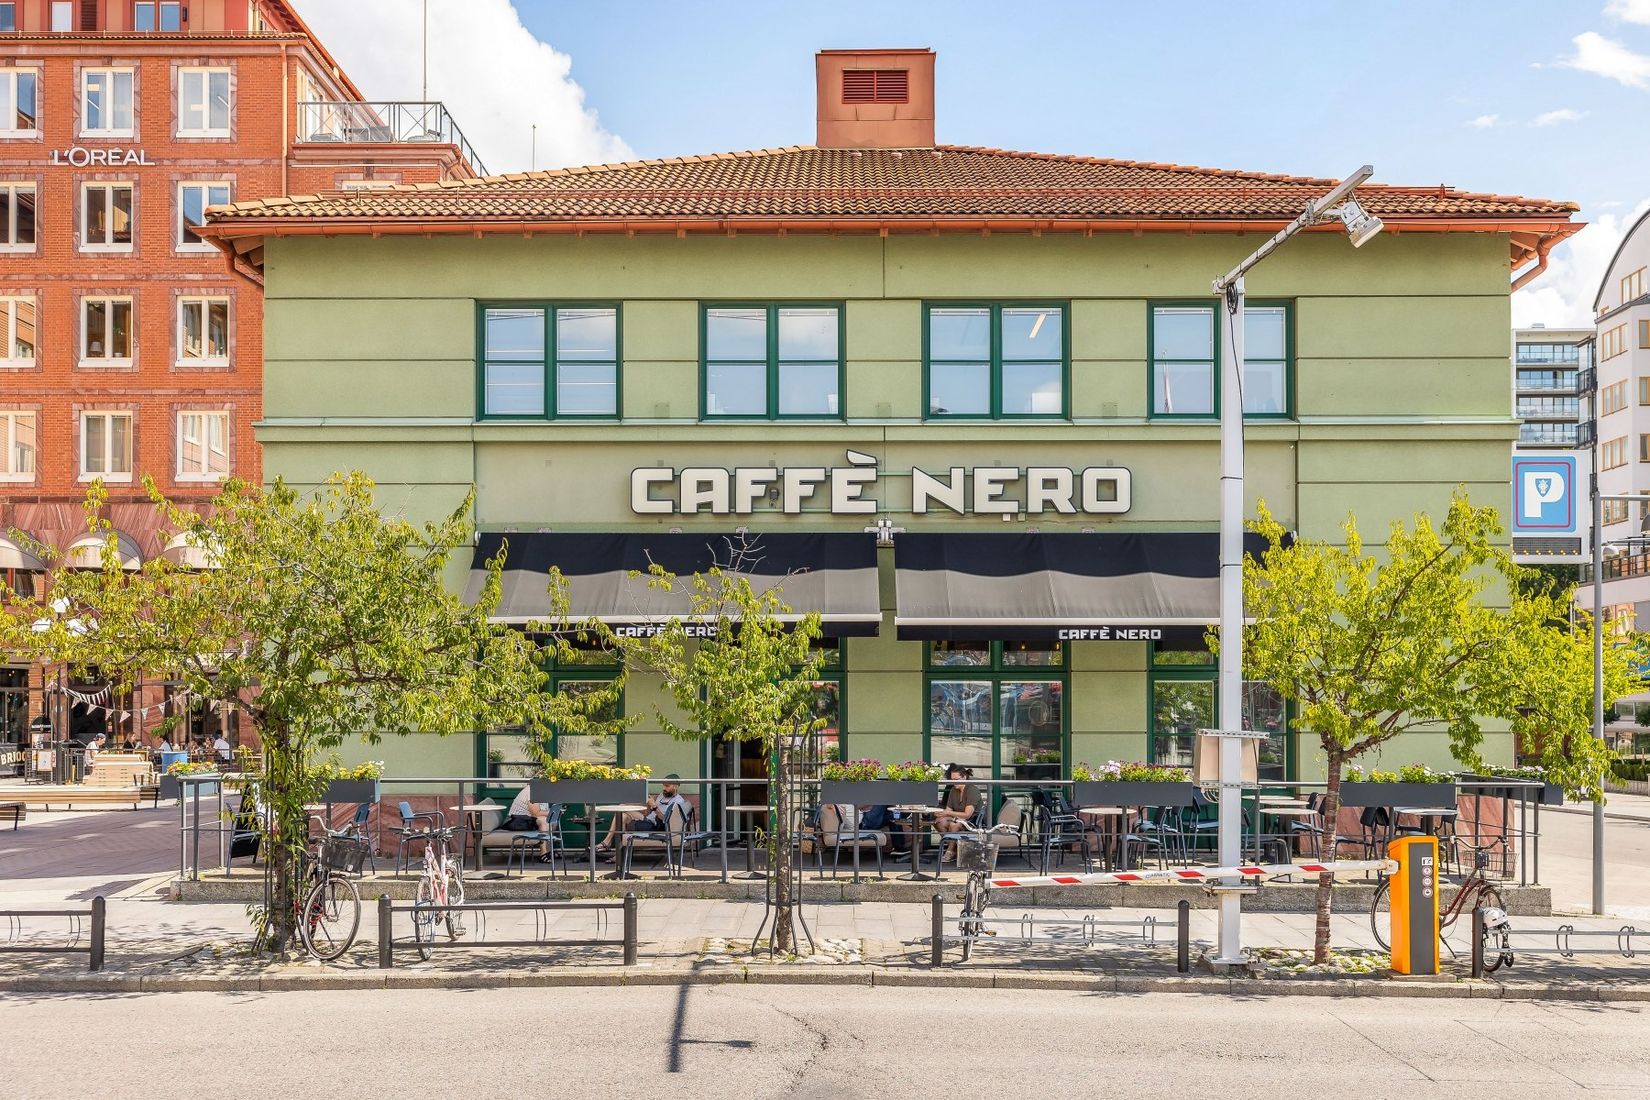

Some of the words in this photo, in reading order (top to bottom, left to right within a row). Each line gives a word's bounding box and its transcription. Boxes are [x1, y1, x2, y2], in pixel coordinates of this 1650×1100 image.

[630, 448, 878, 515] CAFFÈ
[912, 466, 1132, 516] NERO
[1524, 471, 1565, 518] P
[673, 626, 718, 637] ERO
[1058, 626, 1110, 640] CAFFÈ
[1115, 629, 1162, 640] NERO
